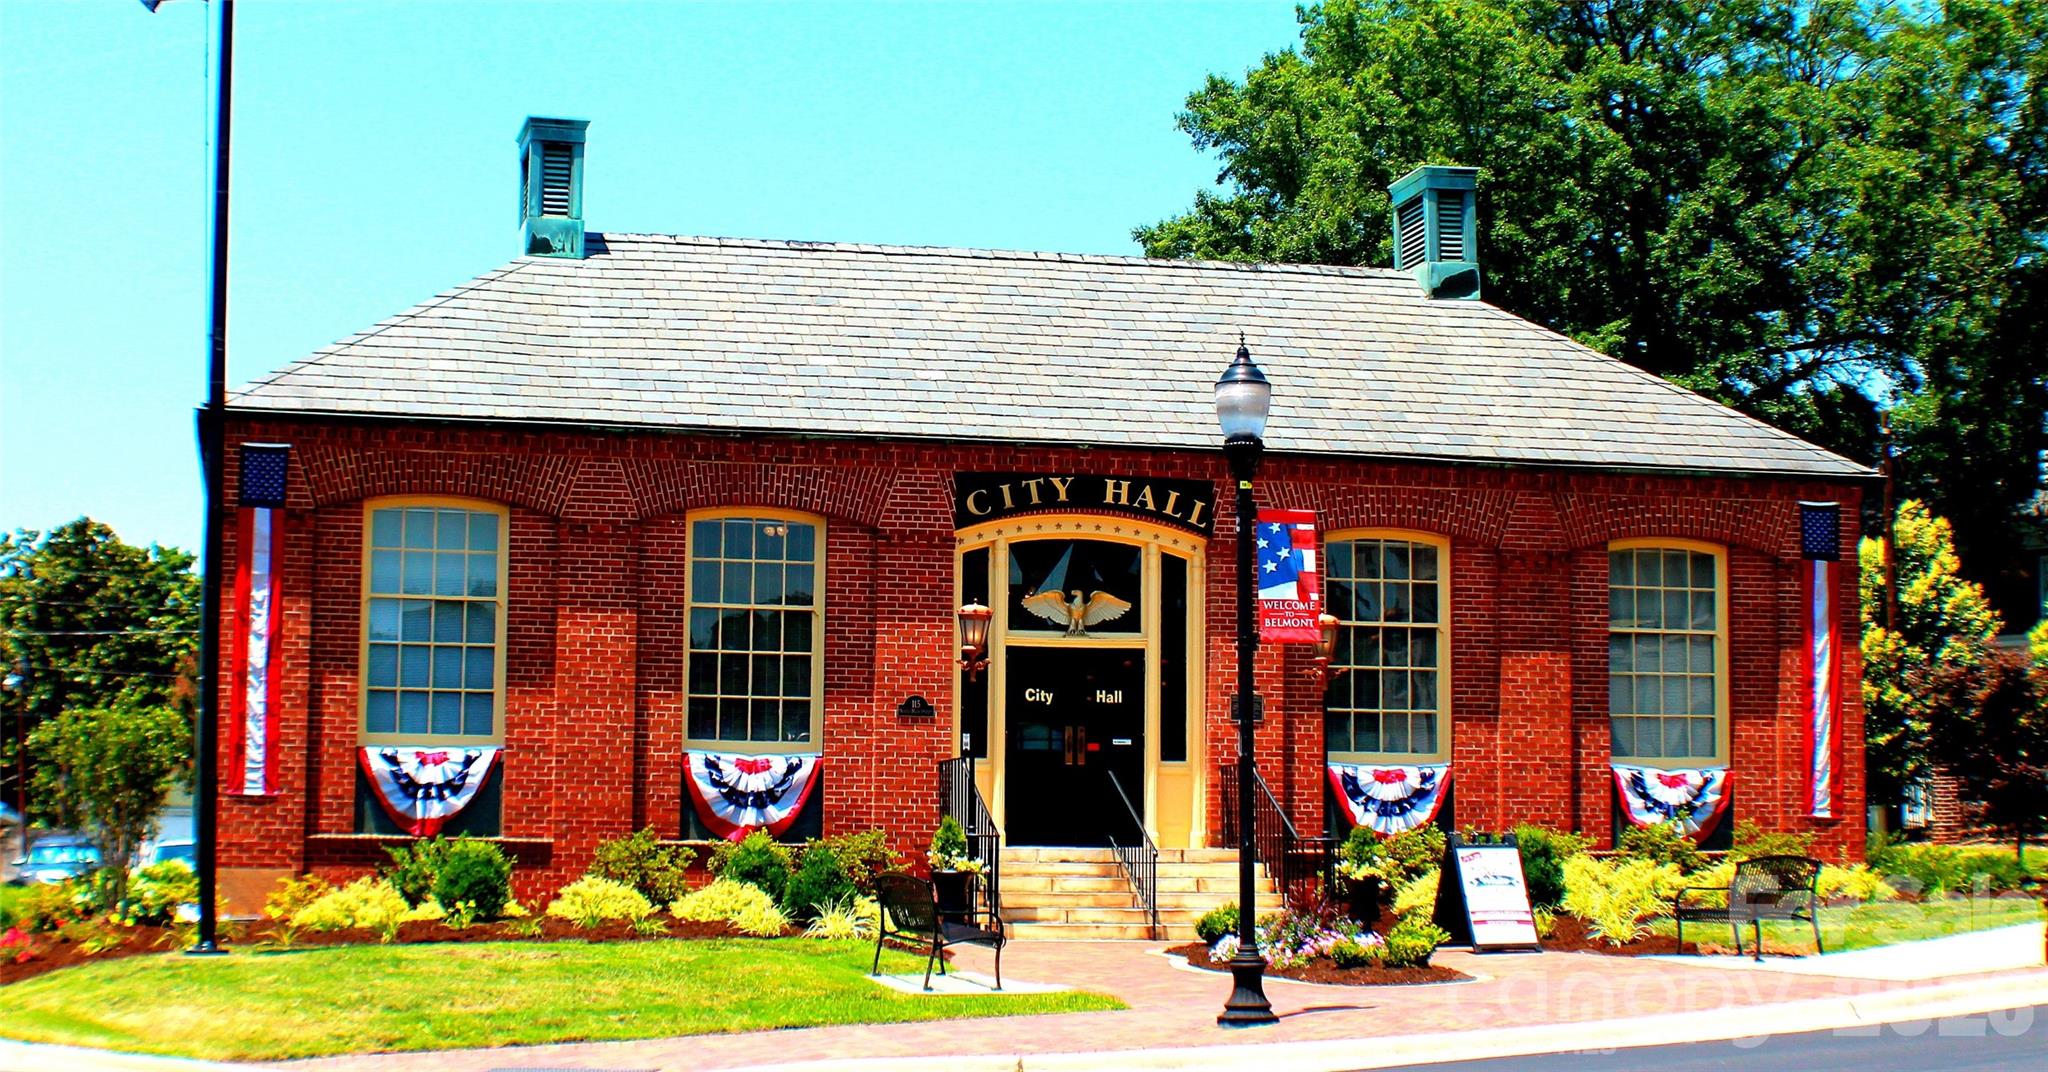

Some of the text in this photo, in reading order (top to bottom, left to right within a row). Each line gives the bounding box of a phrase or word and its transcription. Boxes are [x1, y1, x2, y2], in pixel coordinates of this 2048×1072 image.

[966, 476, 1206, 529] CITY HALL
[1262, 600, 1316, 611] WELCOME
[1264, 617, 1315, 628] BELMONT
[1024, 687, 1123, 706] City Hall
